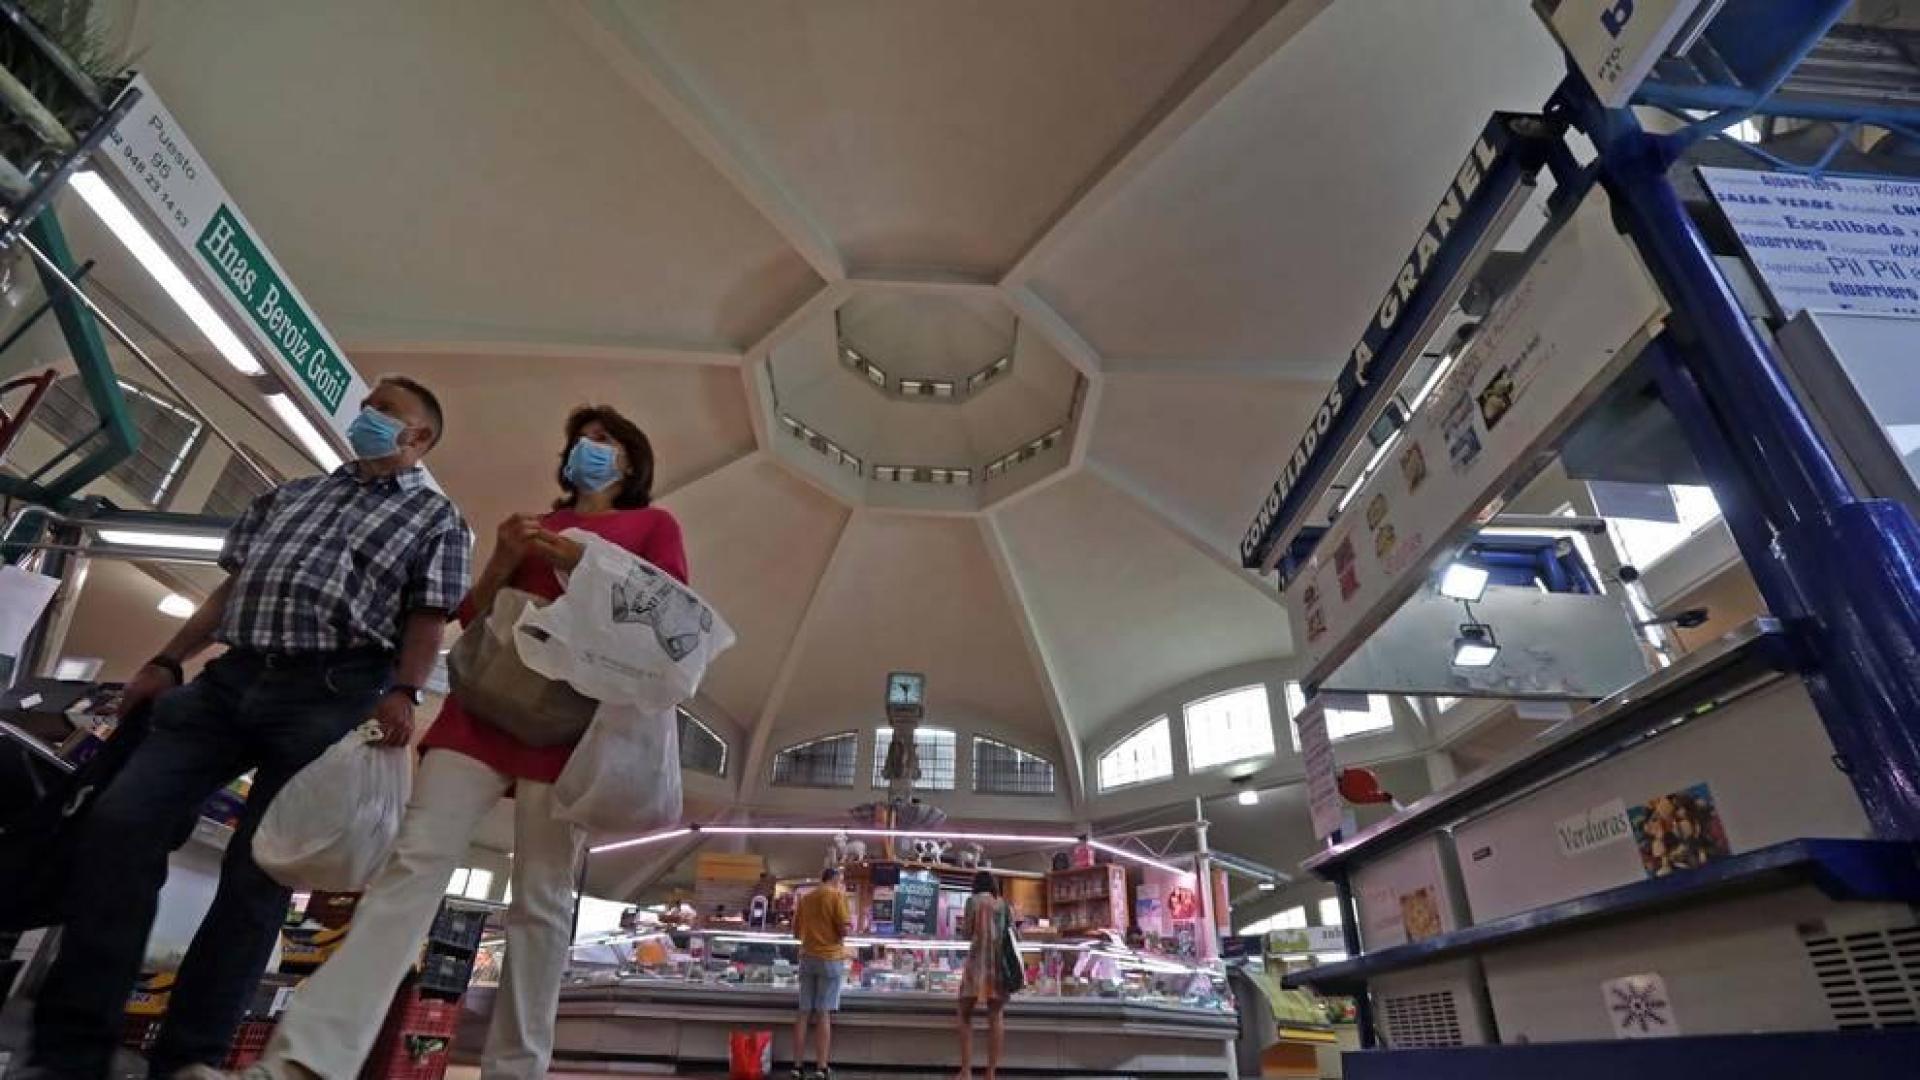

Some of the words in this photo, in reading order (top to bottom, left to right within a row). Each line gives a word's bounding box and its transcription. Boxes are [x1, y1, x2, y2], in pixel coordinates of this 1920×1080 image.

[123, 144, 146, 173] 948
[148, 114, 196, 180] Puesto
[1776, 197, 1835, 211] VERDE
[1784, 214, 1905, 237] Escalibada
[1826, 256, 1865, 277] Pil
[1866, 258, 1907, 280] Pil
[203, 216, 257, 302] Hnas.
[256, 283, 311, 365] Beroiz
[307, 348, 346, 408] Goñi
[1243, 387, 1343, 557] CONGELADOS
[1353, 340, 1374, 386] A
[1380, 135, 1498, 330] GRANEL
[1559, 812, 1629, 850] Verduras
